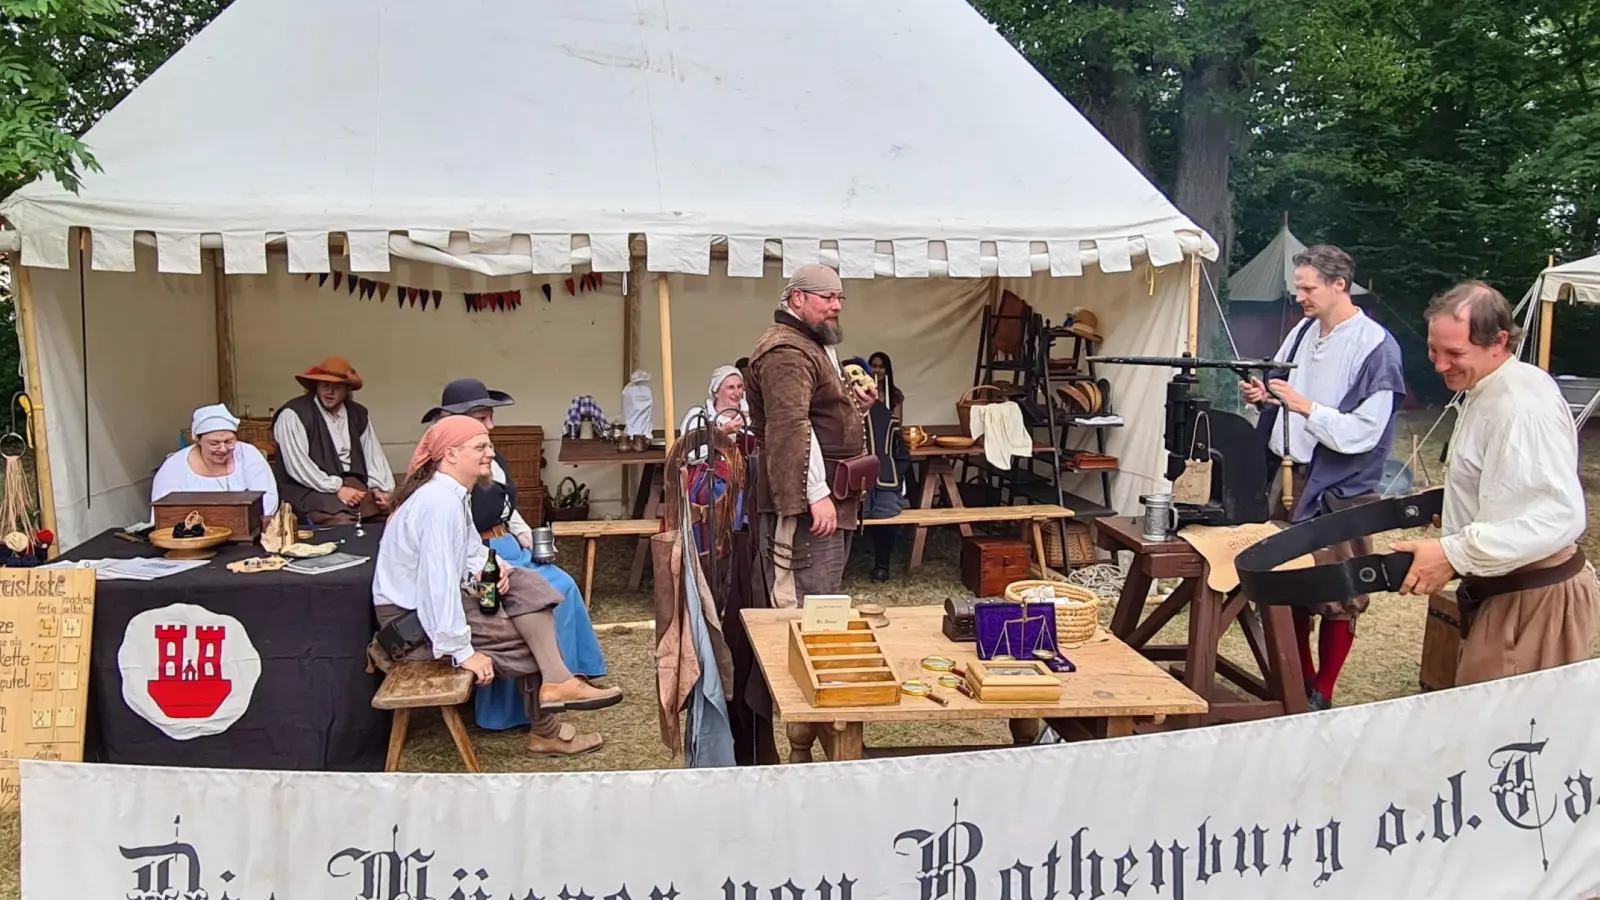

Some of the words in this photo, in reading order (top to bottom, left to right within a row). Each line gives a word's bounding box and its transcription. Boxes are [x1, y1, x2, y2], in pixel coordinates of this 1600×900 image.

[66, 621, 76, 635] 4
[35, 710, 45, 727] 8
[893, 815, 1345, 900] Rothenburg
